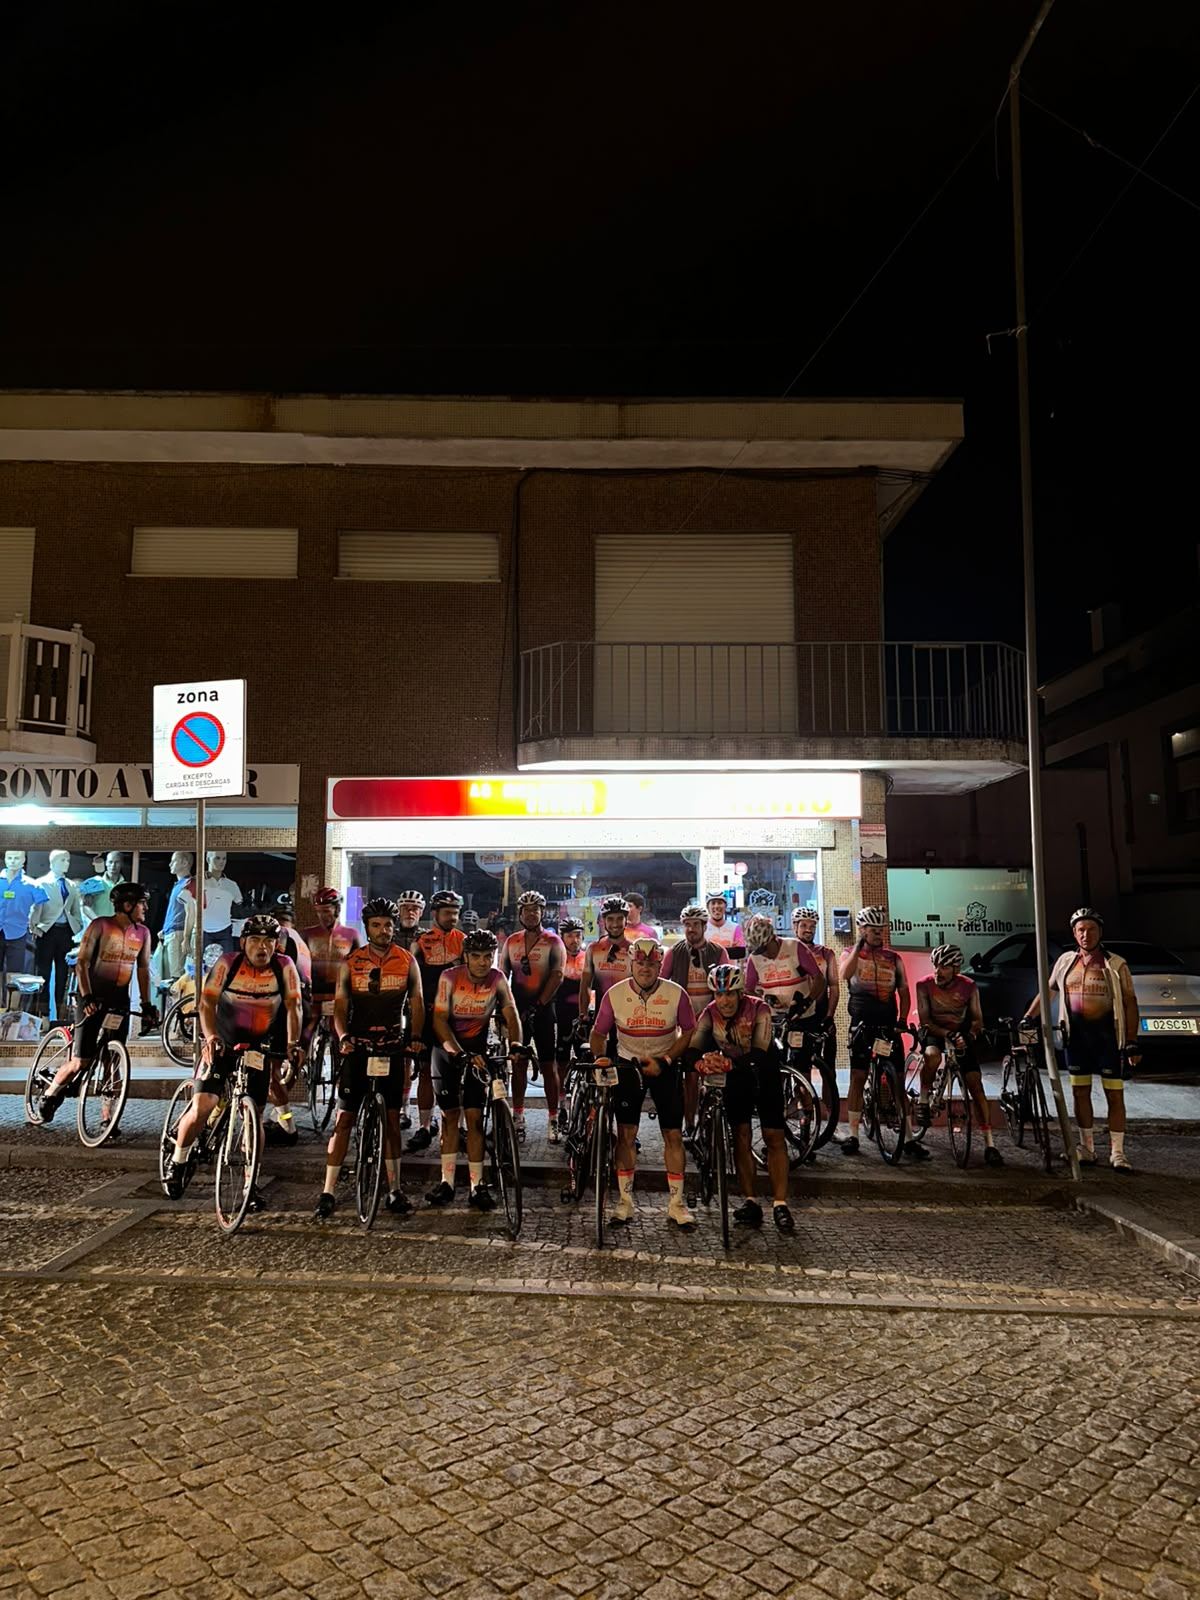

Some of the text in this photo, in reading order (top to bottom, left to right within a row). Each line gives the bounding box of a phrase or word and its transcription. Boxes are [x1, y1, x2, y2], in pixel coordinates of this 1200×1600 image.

[177, 690, 219, 704] zona
[182, 772, 213, 780] EXCEPTO
[195, 778, 232, 787] DESCARGAS
